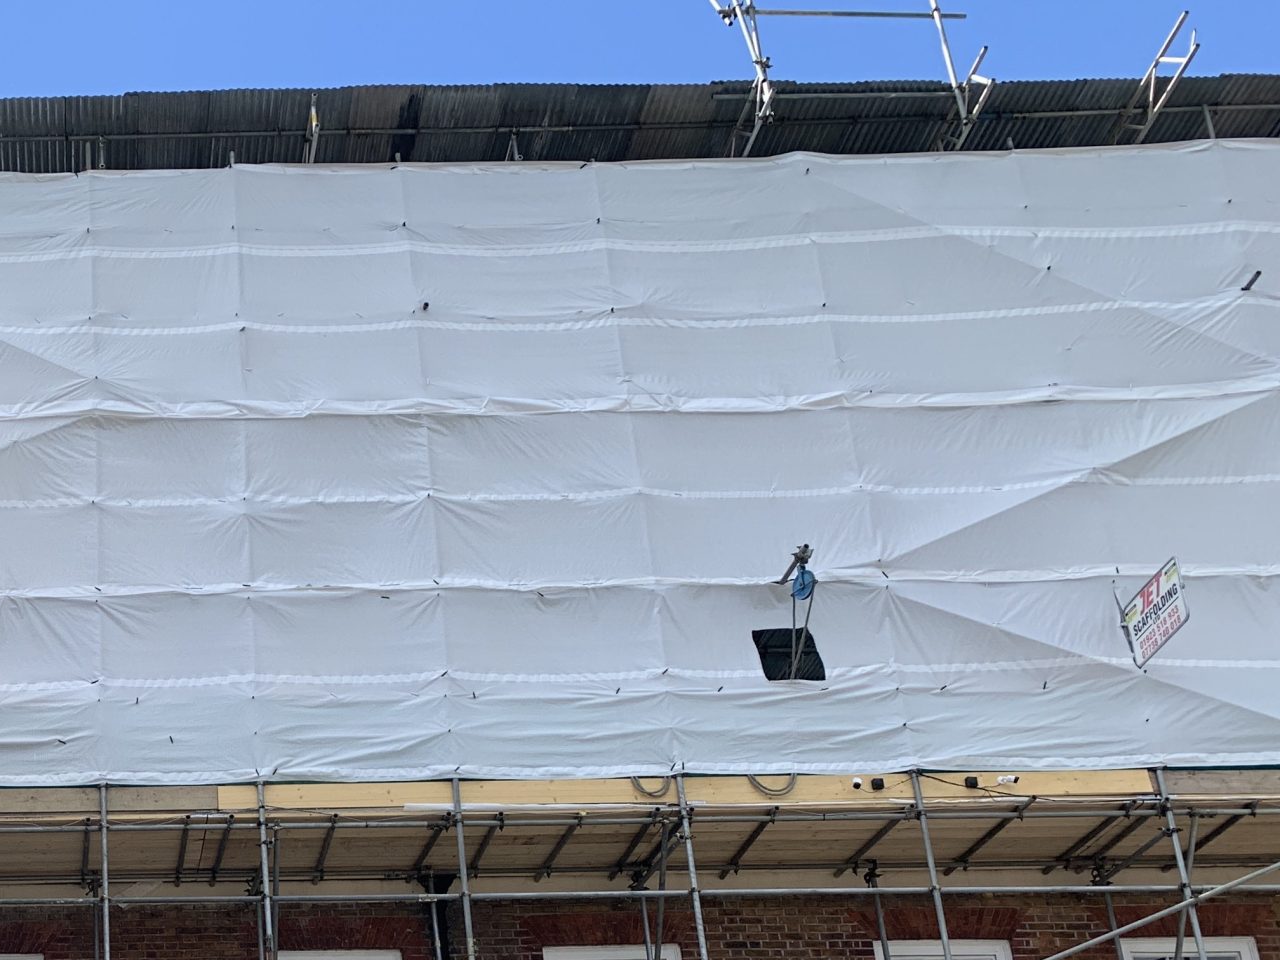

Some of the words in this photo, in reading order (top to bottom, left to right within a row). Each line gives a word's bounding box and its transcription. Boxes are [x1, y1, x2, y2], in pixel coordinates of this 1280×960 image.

[1132, 583, 1178, 637] SCAFFOLDING
[1140, 570, 1164, 616] JET
[1152, 614, 1161, 625] LTD
